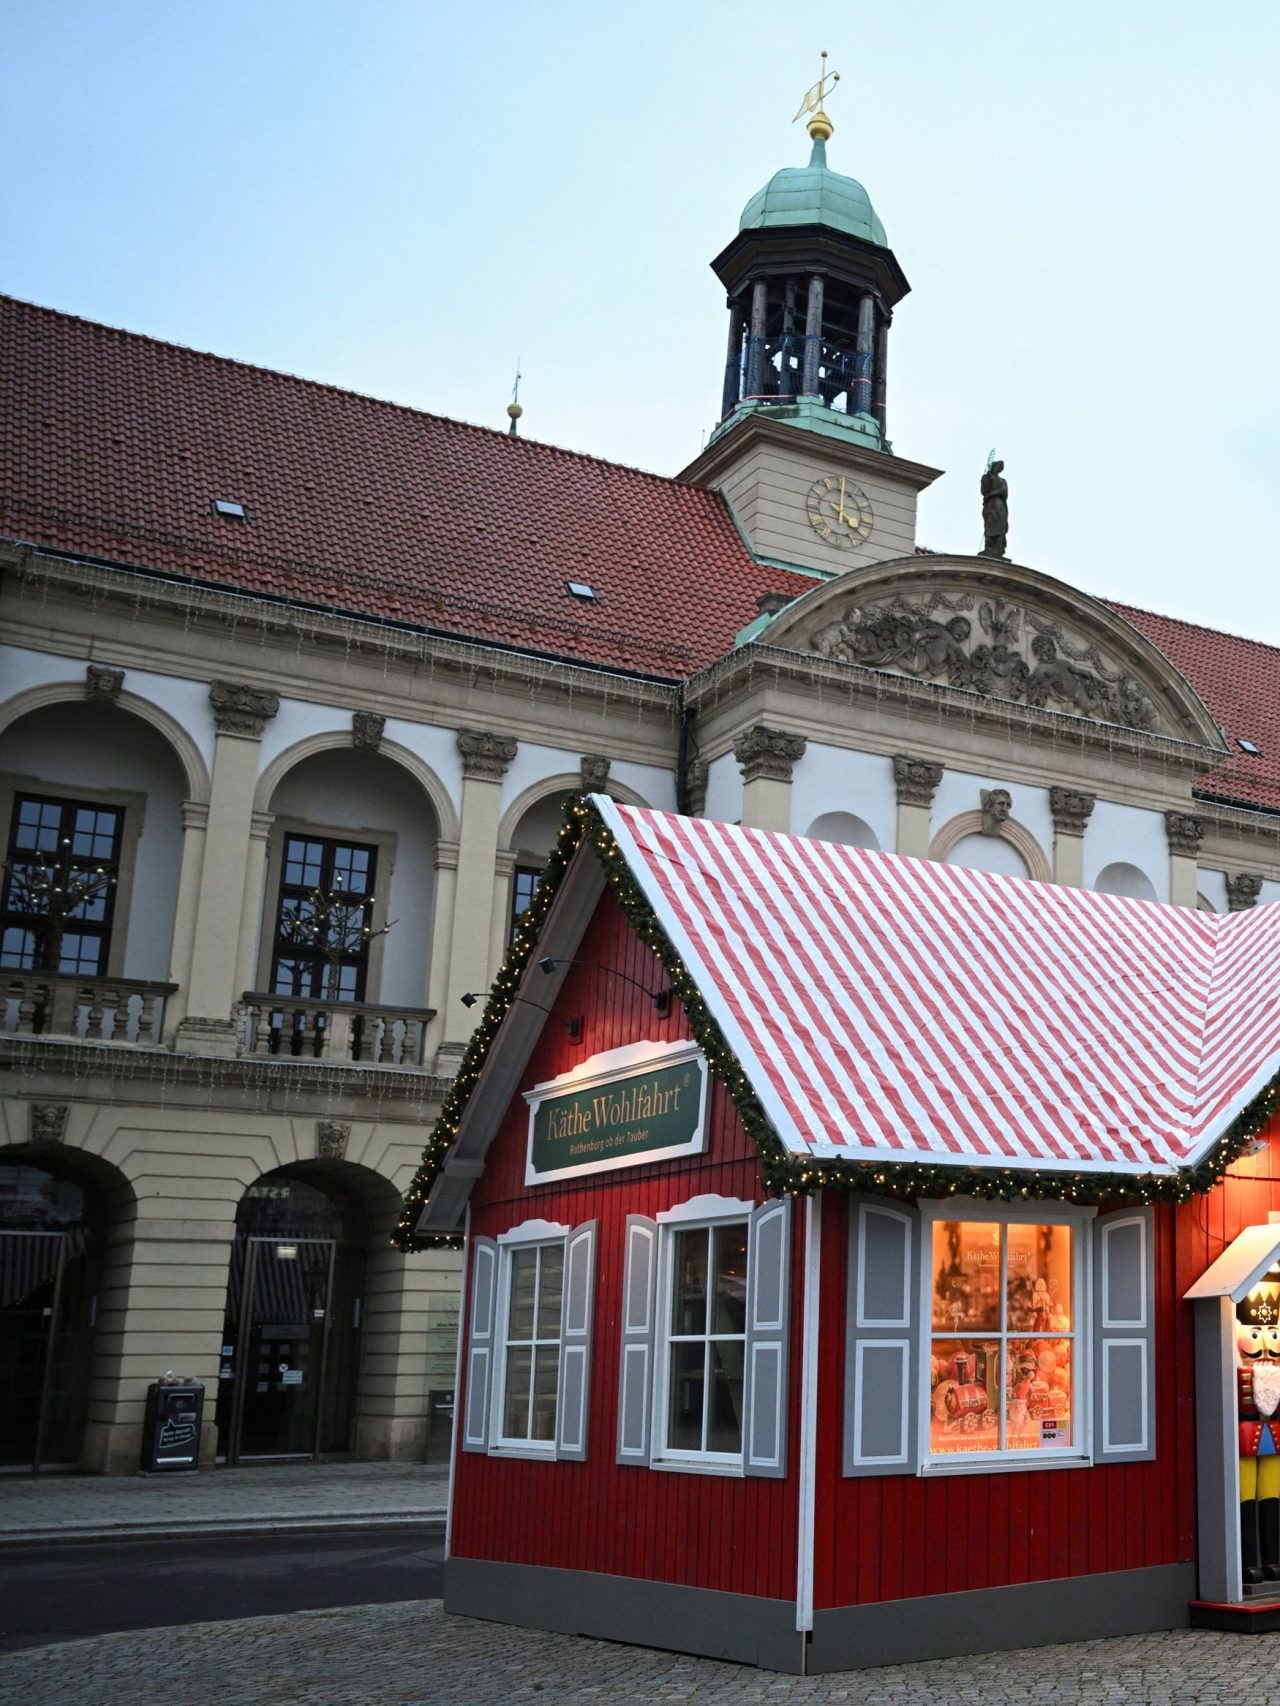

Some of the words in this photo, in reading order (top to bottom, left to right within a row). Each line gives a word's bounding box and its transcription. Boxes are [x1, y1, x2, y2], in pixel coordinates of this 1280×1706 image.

[547, 1102, 592, 1140] Käthe
[569, 1139, 604, 1155] Rothenburg
[605, 1135, 613, 1148] ob
[614, 1131, 625, 1145] der
[627, 1129, 650, 1144] Tauber
